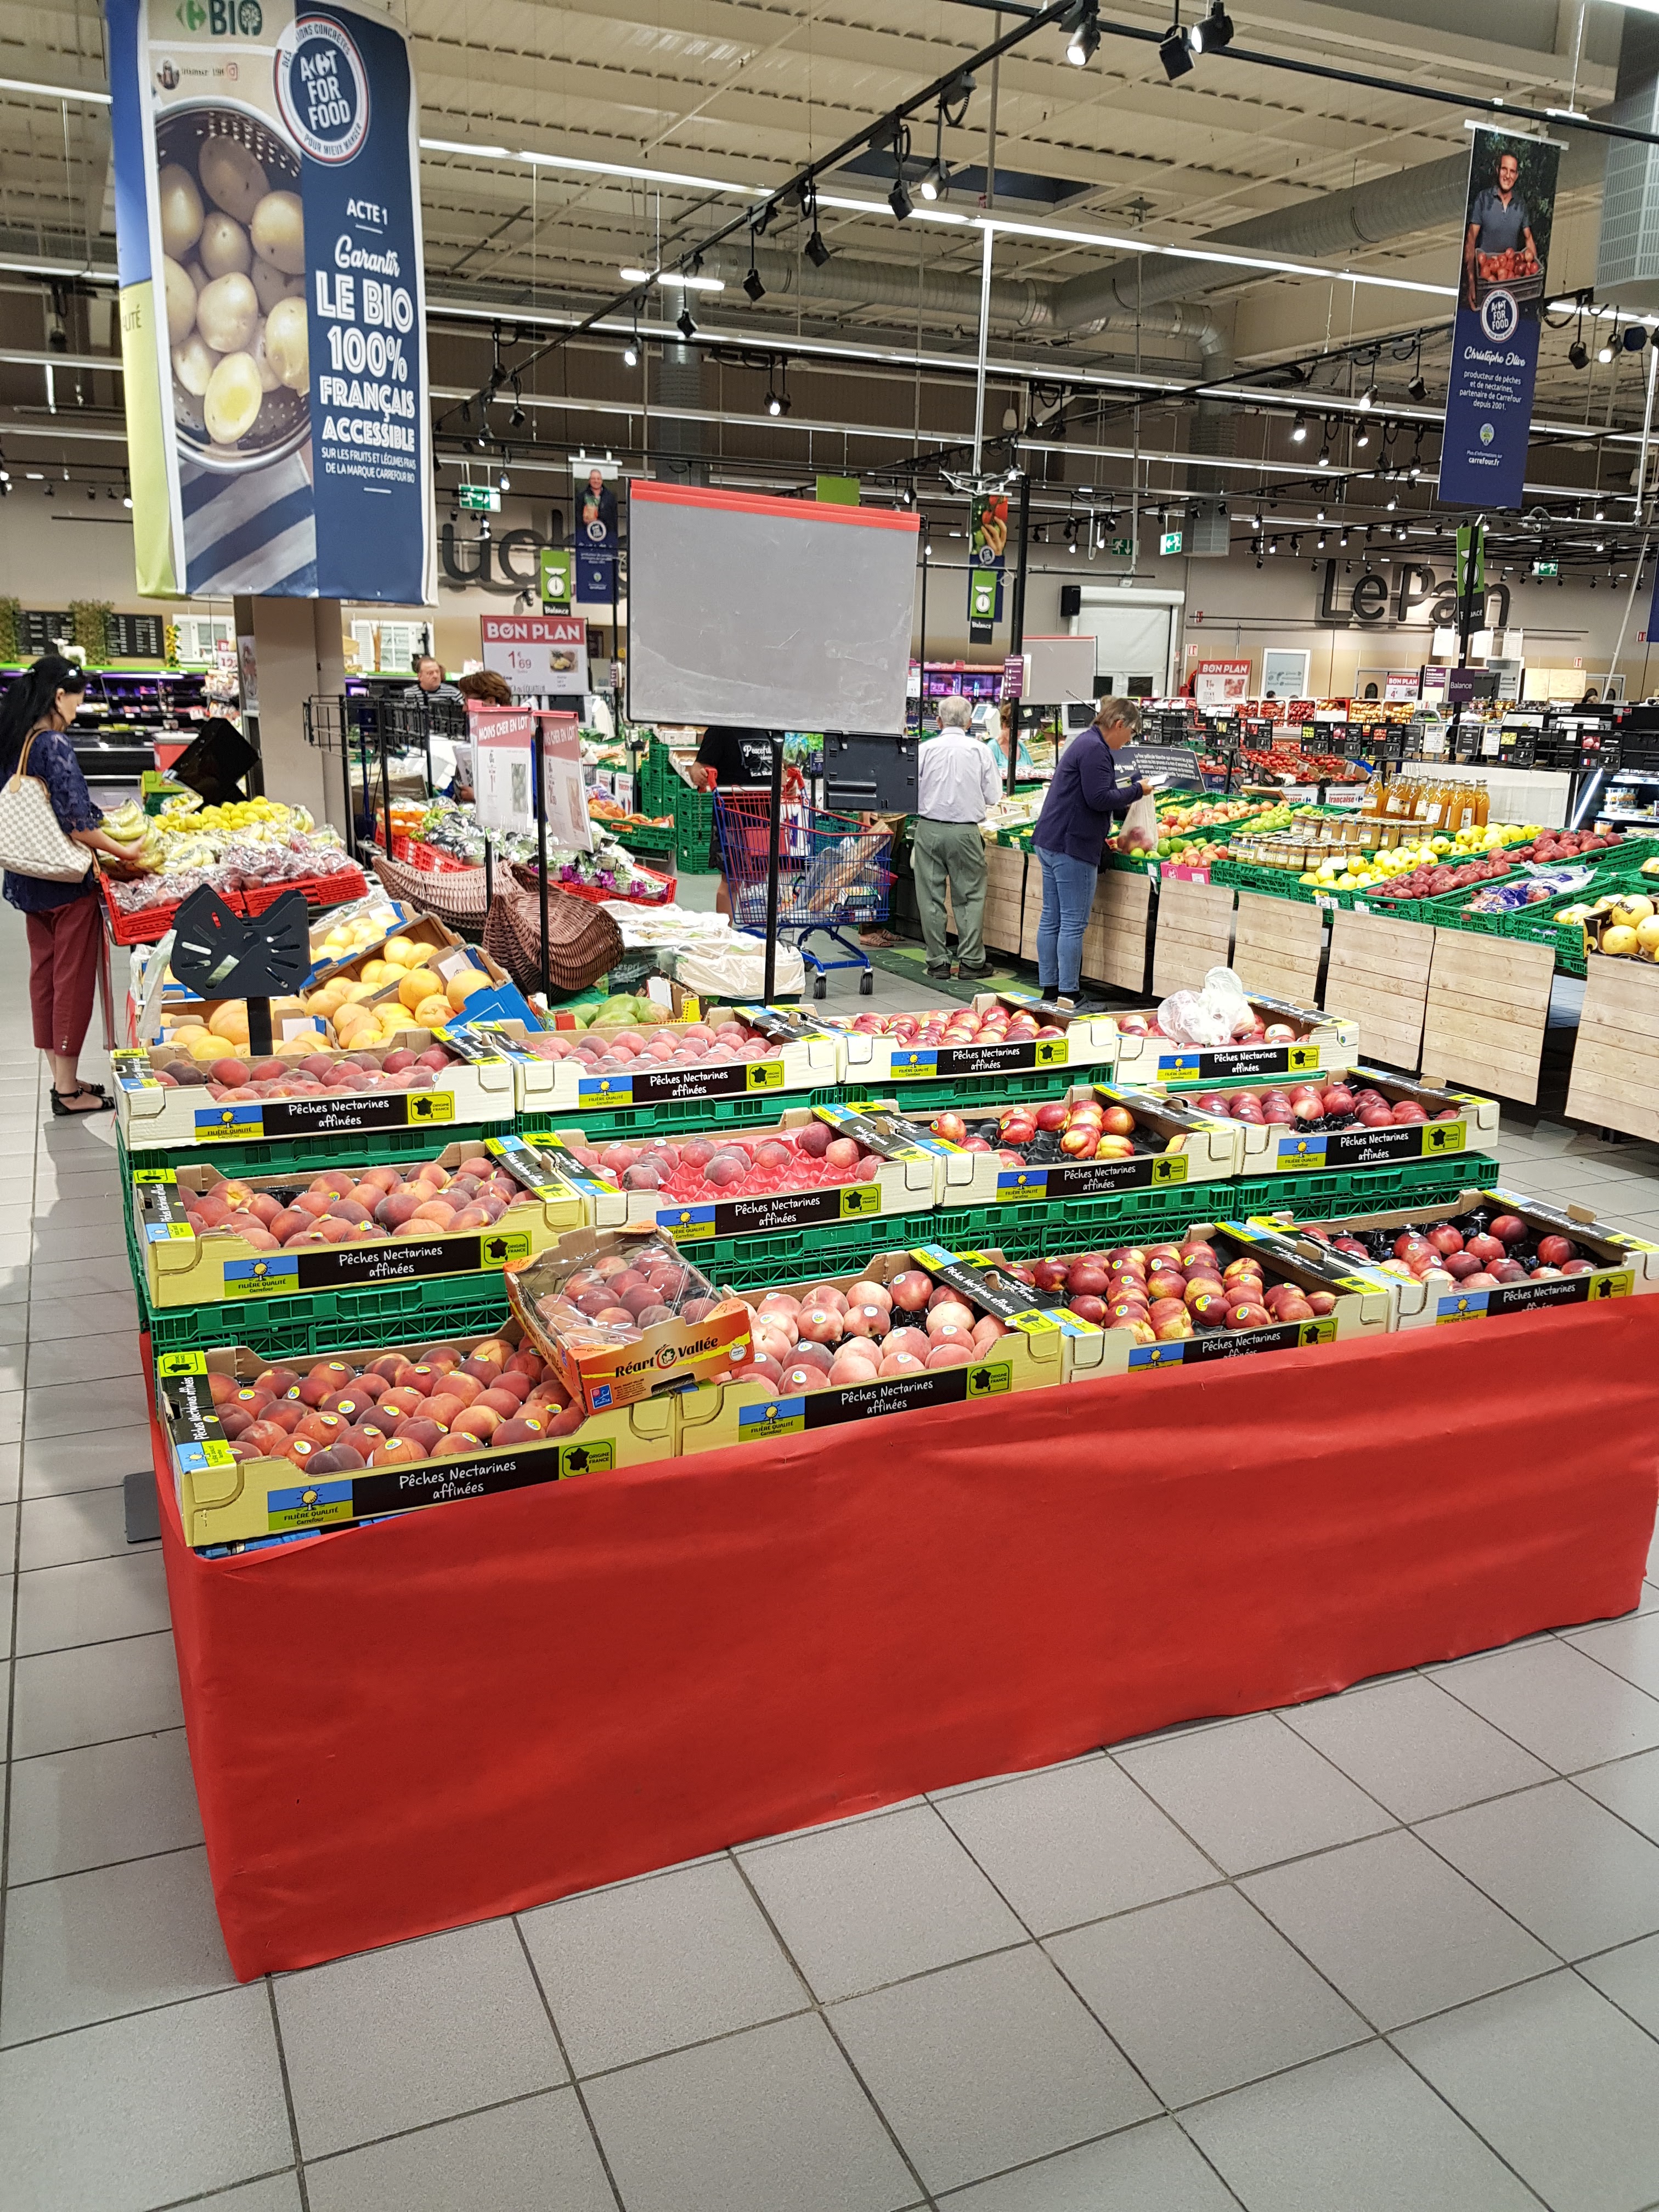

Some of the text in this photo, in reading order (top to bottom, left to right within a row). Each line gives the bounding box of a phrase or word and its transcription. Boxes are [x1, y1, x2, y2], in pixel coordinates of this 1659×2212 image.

[209, 0, 262, 35] BIO
[300, 49, 337, 82] ACT
[307, 76, 342, 105] FOR
[308, 99, 351, 131] FOOD
[346, 198, 388, 225] ACTE 1
[335, 234, 400, 278] Garantir
[315, 269, 414, 334] LE BIO
[1491, 300, 1506, 312] ACT
[1493, 310, 1506, 321] FOR
[1492, 319, 1509, 330] FOOD
[327, 325, 408, 382] 100%
[1464, 370, 1521, 385] producteur de pêches
[1485, 382, 1513, 393] nectarines,
[319, 375, 415, 422] FRANÇAIS
[1459, 389, 1521, 403] partenaire de Carrefour
[1473, 399, 1506, 410] depuis 2001.
[321, 415, 415, 452] ACCESSIBLE
[321, 447, 336, 459] SUR
[337, 448, 349, 460] LES
[349, 449, 372, 463] FRUITS
[372, 452, 380, 464] ET
[380, 452, 403, 467] LÉGUMES
[1468, 456, 1500, 466] carrefour.fr
[325, 462, 336, 473] DE
[336, 463, 347, 475] LA
[347, 465, 375, 479] MARQUE
[375, 467, 407, 483] CARREFOUR
[1321, 559, 1510, 627] Le Pan
[544, 605, 569, 616] Balance
[487, 622, 580, 641] BON PLAN
[971, 621, 991, 630] Balance
[1202, 664, 1248, 673] BON PLAN
[478, 717, 528, 741] MOINS CHER EN LOT
[1329, 795, 1354, 804] française
[953, 1047, 1020, 1061] Pêches Nectarines
[1214, 1051, 1277, 1063] Pêches Nectarines
[970, 1060, 1001, 1070] affinées
[1232, 1063, 1259, 1073] affinées
[650, 1070, 729, 1087] Pêches Nectarines
[673, 1085, 707, 1097] affinées
[288, 1098, 390, 1116] Pêches Nectarines
[318, 1114, 362, 1127] affinées
[207, 1126, 252, 1136] FILIÈRE QUALITÉ
[1341, 1132, 1409, 1148] Pêches Nectarines
[1358, 1149, 1389, 1161] affinées
[1064, 1165, 1136, 1181] Pêches Nectarines
[1083, 1179, 1115, 1190] affinées
[736, 1197, 821, 1216] Pêches Nectarines
[759, 1214, 797, 1226] affinées
[339, 1246, 443, 1267] Pêches Nectarines
[369, 1263, 415, 1277] affinées
[262, 1279, 286, 1288] QUALITÉ
[943, 1266, 1015, 1314] Pêches Nectarines affinées
[1503, 1284, 1576, 1303] Pêches Nectarines
[1202, 1332, 1281, 1353] Pêches Nectarines
[616, 1336, 718, 1378] Réart Vallée
[179, 1376, 196, 1395] affinées
[841, 1380, 933, 1405] Pêches Nectarines
[185, 1396, 204, 1422] Nectarines
[867, 1398, 907, 1414] affinées
[191, 1421, 210, 1441] Pêches
[771, 1421, 794, 1431] QUALITÉ
[399, 1460, 516, 1490] Pêches Nectarines
[433, 1481, 484, 1500] affinées
[284, 1506, 339, 1521] FILIÈRE QUALITÉ
[296, 1515, 324, 1525] Carrefour
